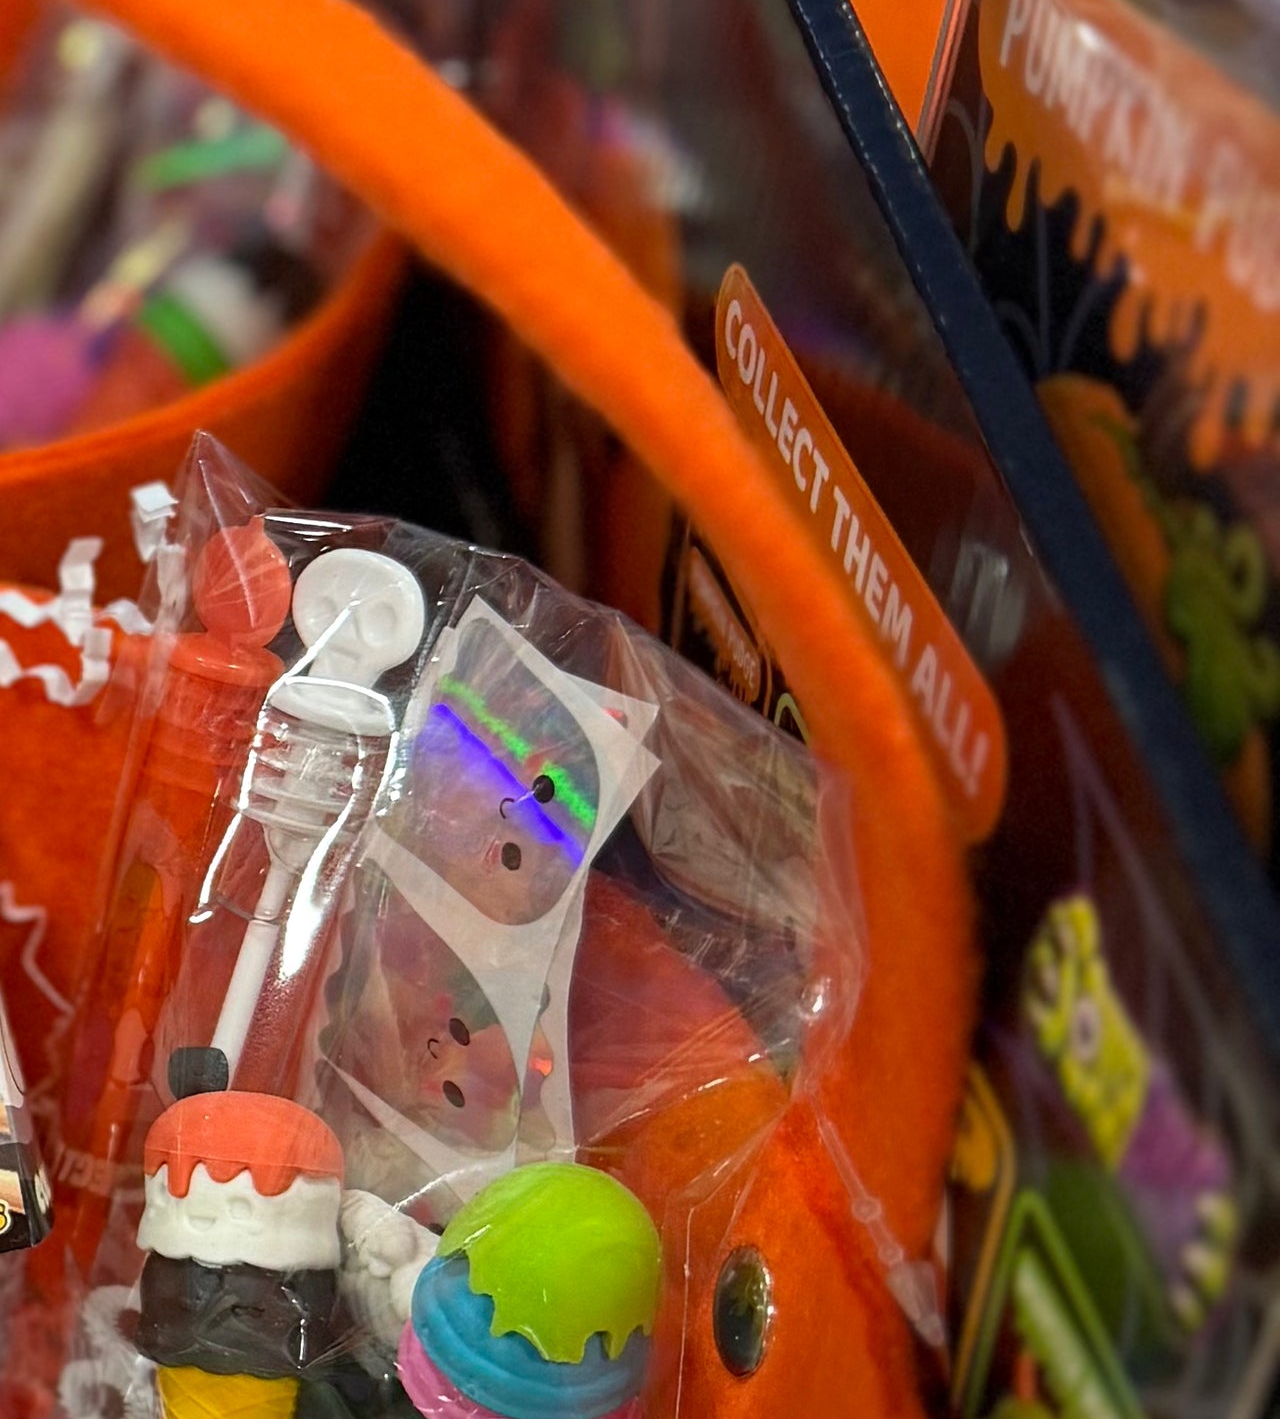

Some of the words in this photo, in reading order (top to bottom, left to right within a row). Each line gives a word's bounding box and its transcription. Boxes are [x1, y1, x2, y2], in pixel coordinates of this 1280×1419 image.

[725, 299, 830, 513] COLLECT
[830, 486, 913, 670] THEM
[910, 643, 990, 798] ALL!
